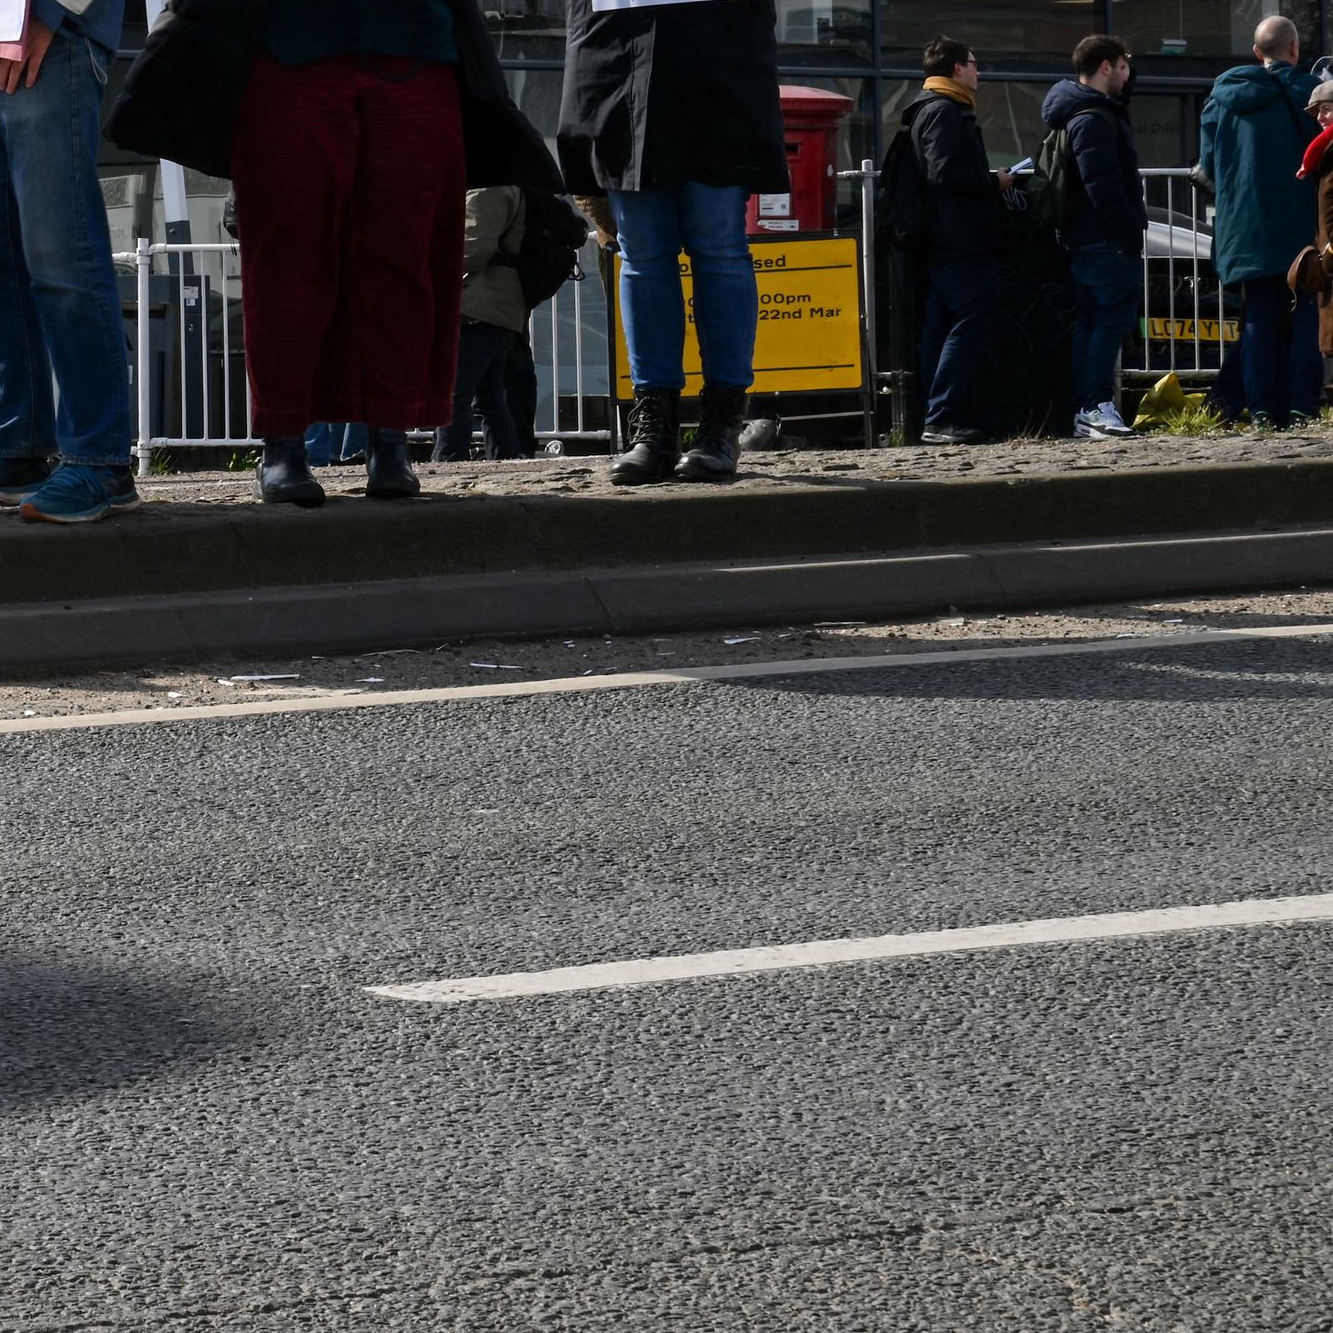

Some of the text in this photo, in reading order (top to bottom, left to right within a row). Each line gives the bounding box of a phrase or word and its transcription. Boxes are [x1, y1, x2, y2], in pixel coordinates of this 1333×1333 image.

[754, 254, 787, 269] sed
[760, 293, 811, 306] 00pm
[759, 306, 842, 321] 22nd Mar
